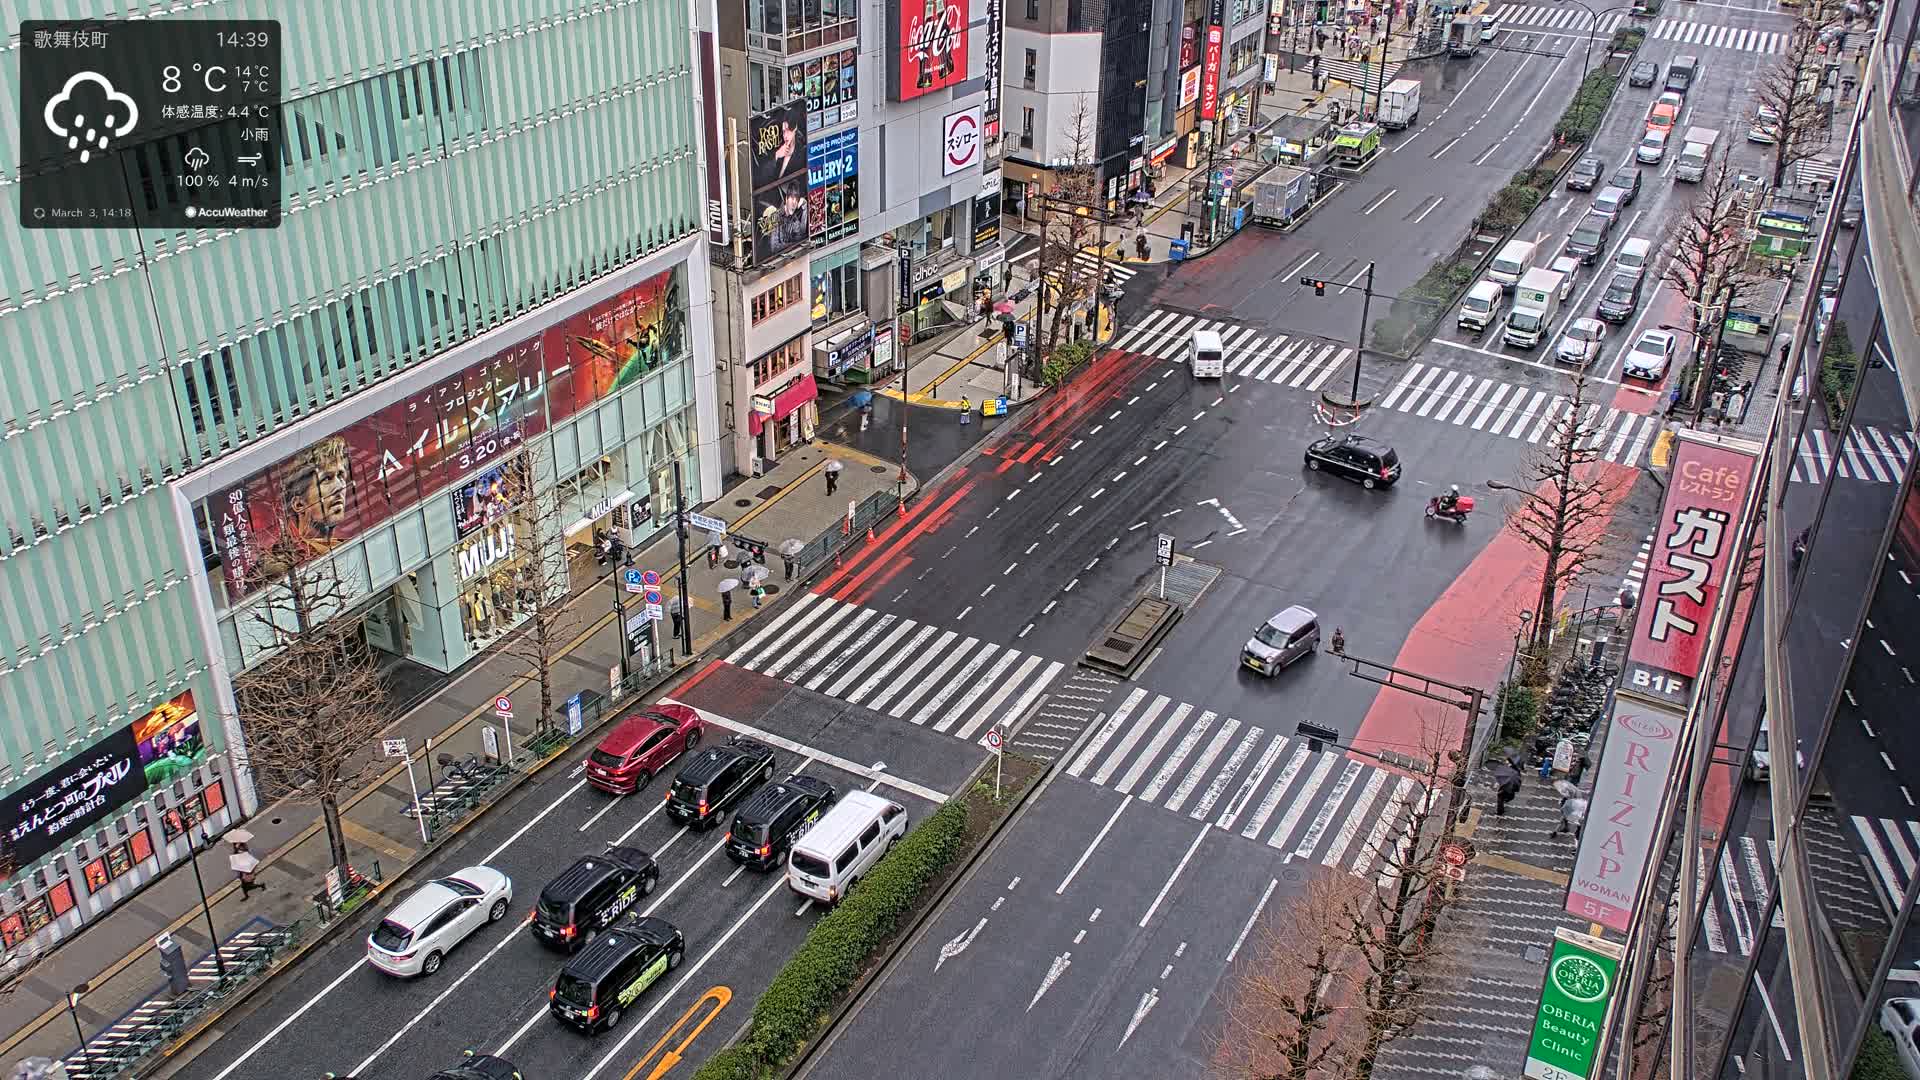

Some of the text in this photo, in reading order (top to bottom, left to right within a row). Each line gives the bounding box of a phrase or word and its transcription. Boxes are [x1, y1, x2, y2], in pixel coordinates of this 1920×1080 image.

[1204, 46, 1219, 110] バーガーキング
[947, 133, 978, 152] スシロー
[709, 200, 722, 232] MUJI
[1017, 325, 1025, 335] P
[408, 340, 541, 412] ライアン・ゴズリング
[445, 378, 503, 412] プロジェクト
[459, 439, 496, 469] 3.20
[1682, 460, 1741, 489] Café
[1680, 479, 1736, 502] レストラン
[592, 496, 613, 519] MUJI
[459, 523, 515, 581] MUJI
[1160, 540, 1168, 548] P
[629, 573, 635, 581] P
[1650, 507, 1729, 642] ガスト
[1632, 668, 1684, 695] B1F
[1597, 741, 1650, 880] RIZAP
[1577, 879, 1631, 903] WOMAN
[601, 891, 638, 927] S.RIDE
[1584, 901, 1614, 919] 5F
[1559, 969, 1600, 991] OBERIA
[1542, 1003, 1597, 1032] OBERIA
[1542, 1019, 1590, 1046] Beauty
[1541, 1038, 1583, 1061] Clinic
